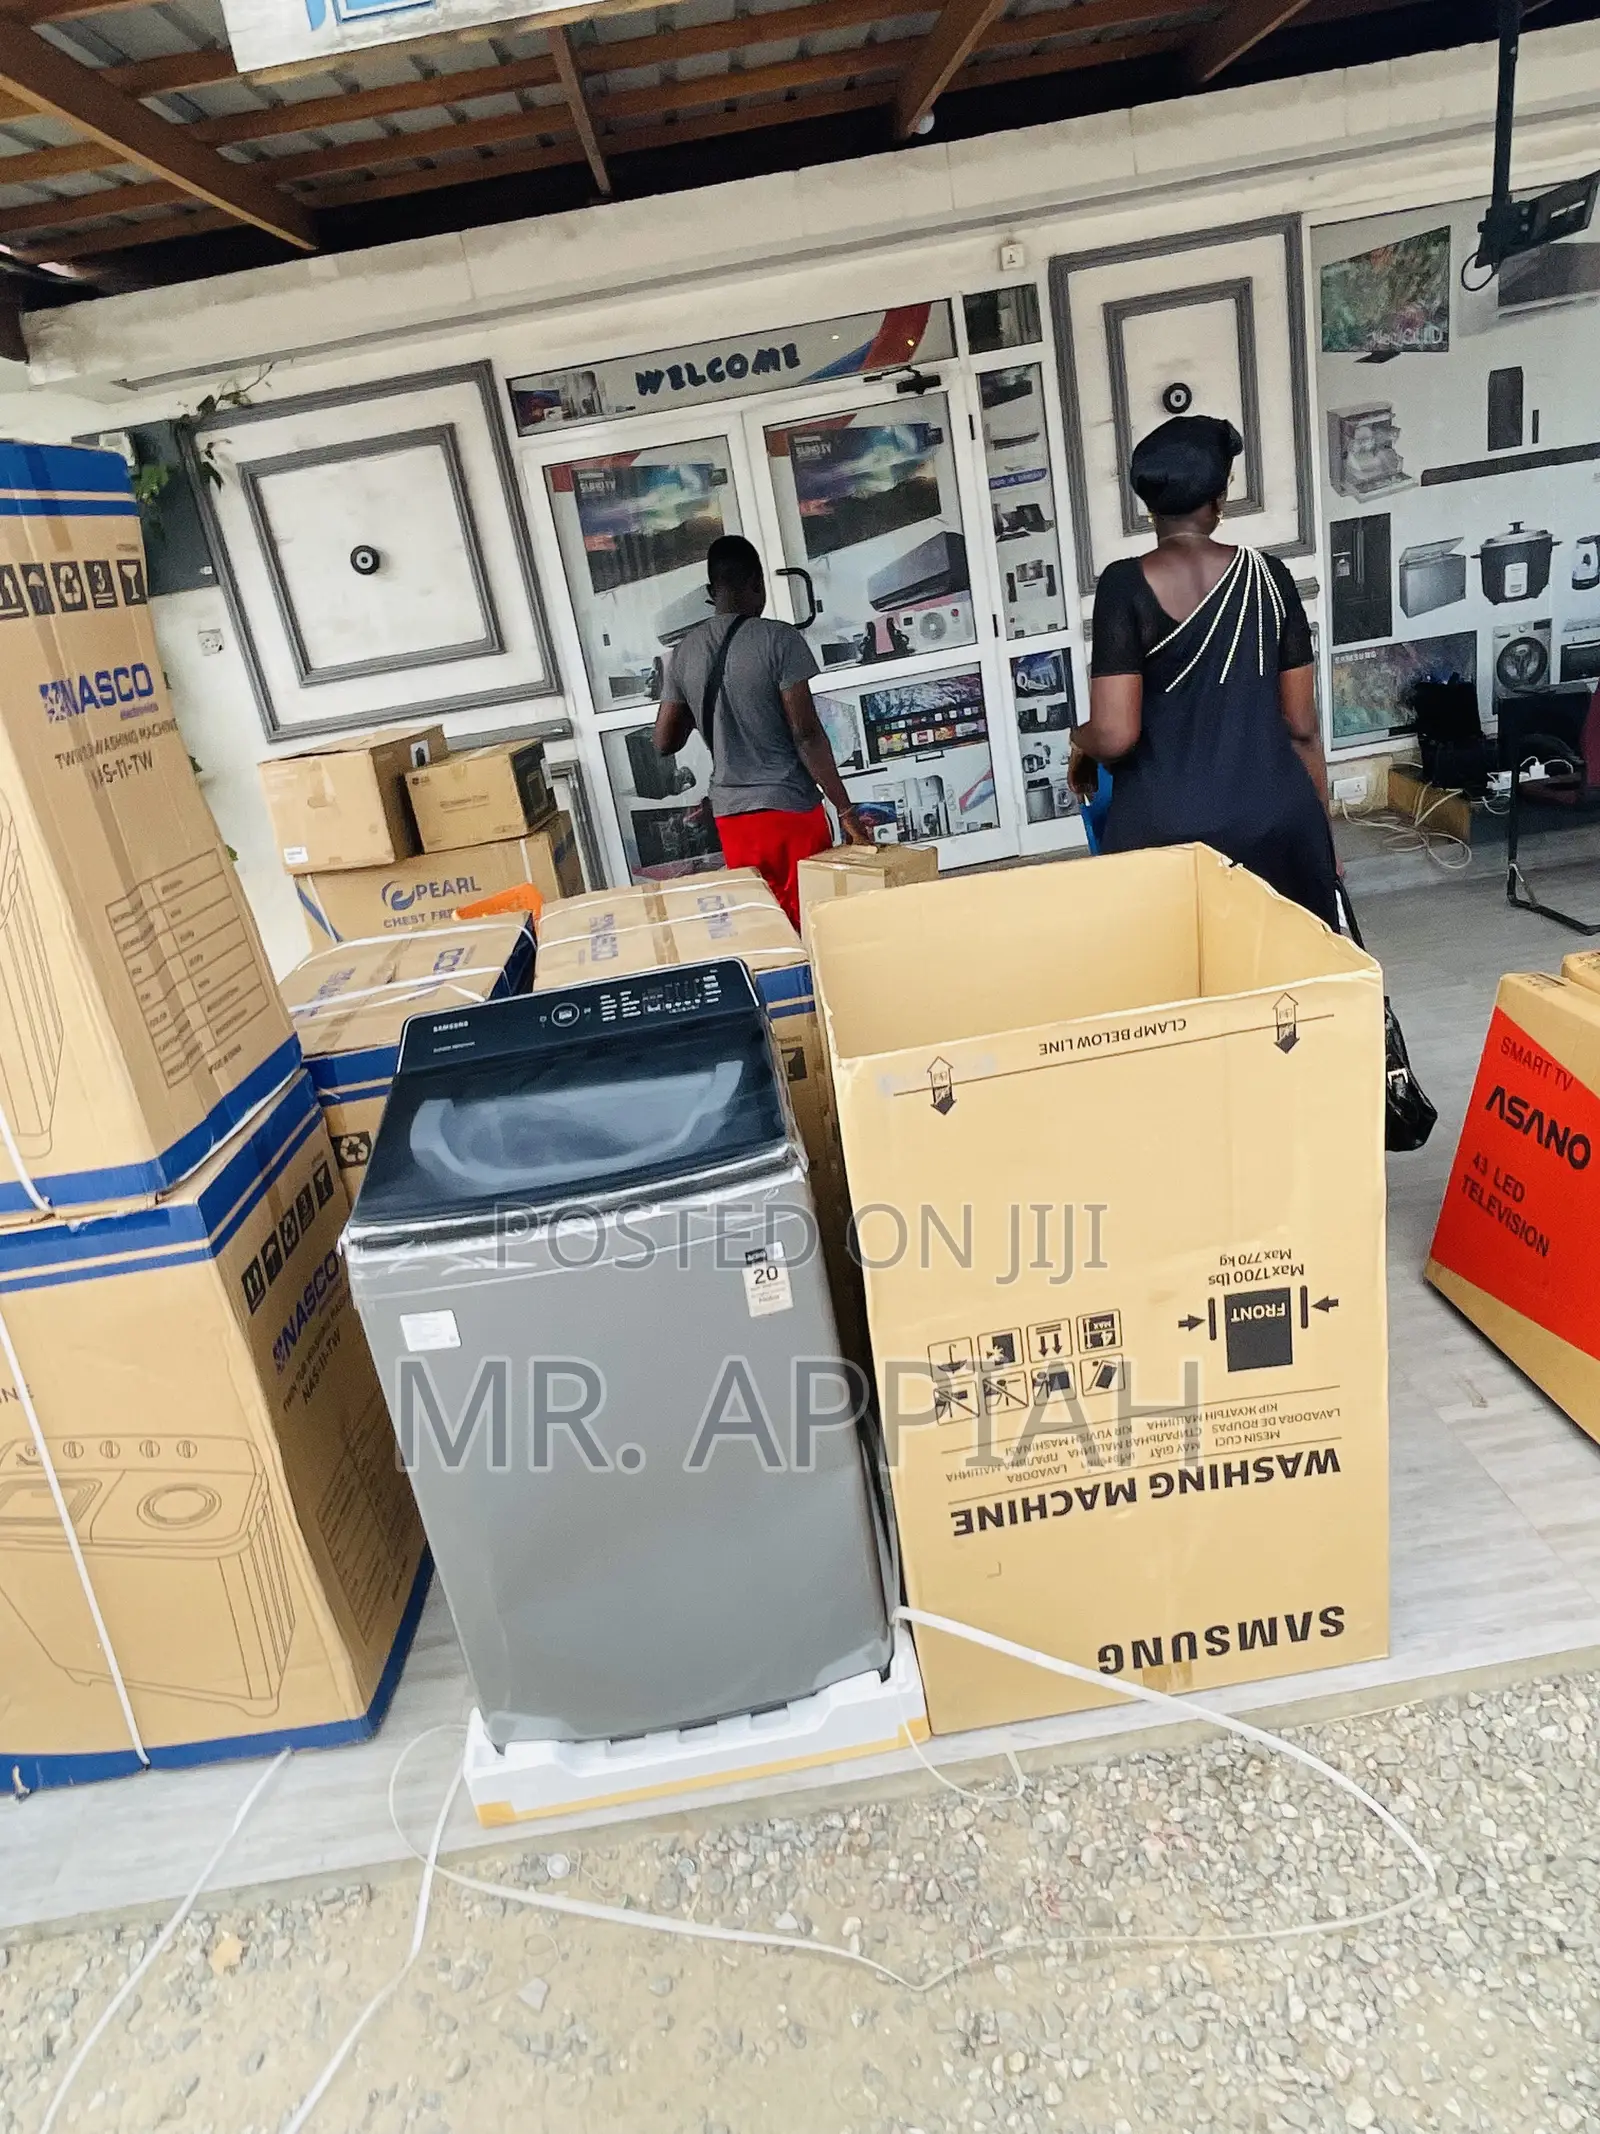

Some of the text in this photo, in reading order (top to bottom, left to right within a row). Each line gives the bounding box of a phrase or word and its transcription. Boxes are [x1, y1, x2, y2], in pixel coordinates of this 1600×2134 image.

[635, 341, 801, 396] WELCOME
[62, 661, 154, 717] NASCO
[416, 876, 482, 900] PEARL
[383, 913, 426, 928] CHEST
[1038, 1018, 1187, 1056] CLAMP BELOW LINE
[1501, 1037, 1573, 1092] SMART TV
[1485, 1085, 1591, 1170] ASANO
[1472, 1152, 1525, 1203] 43 LED
[1462, 1174, 1549, 1257] TELEVISION
[753, 1265, 779, 1285] 20
[1208, 1271, 1231, 1288] lbs
[1219, 1254, 1236, 1268] kg
[281, 1249, 339, 1359] NASCO
[1230, 1302, 1286, 1323] FRONT
[1211, 1407, 1341, 1434] LAVADORA DE ROUPAS
[1215, 1429, 1280, 1447] MESIN CUCI
[950, 1448, 1341, 1537] WASHING MACHINE
[1006, 1464, 1067, 1483] LAVADORA
[1097, 1605, 1345, 1675] SAMSUNG
